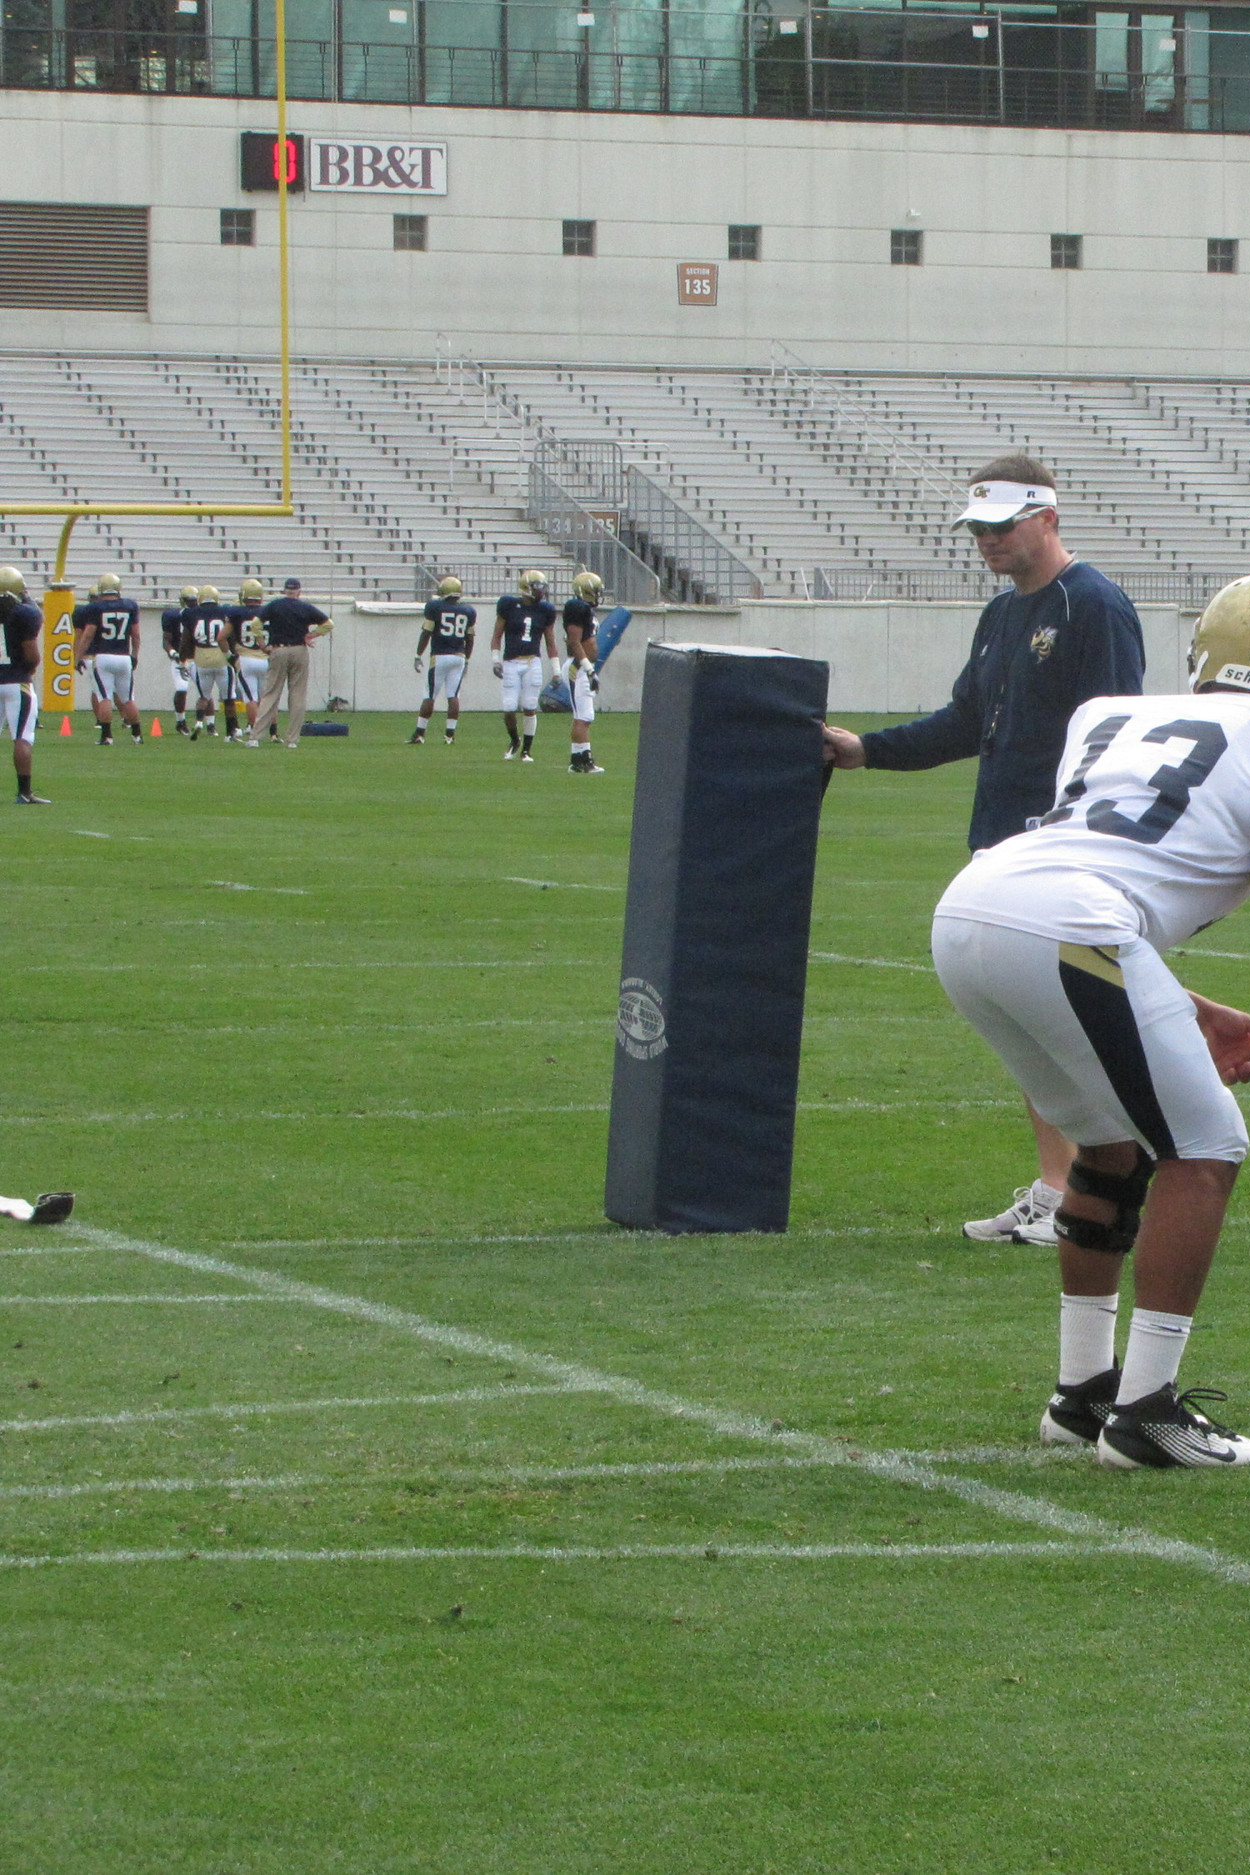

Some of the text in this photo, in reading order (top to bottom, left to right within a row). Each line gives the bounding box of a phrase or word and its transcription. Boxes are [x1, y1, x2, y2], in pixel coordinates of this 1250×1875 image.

[314, 143, 444, 190] BB&T
[684, 279, 711, 295] 135
[101, 612, 130, 640] 57
[194, 619, 225, 647] 40
[440, 612, 469, 638] 58
[521, 616, 533, 642] 1
[52, 612, 73, 696] ACC
[1041, 715, 1228, 844] 13
